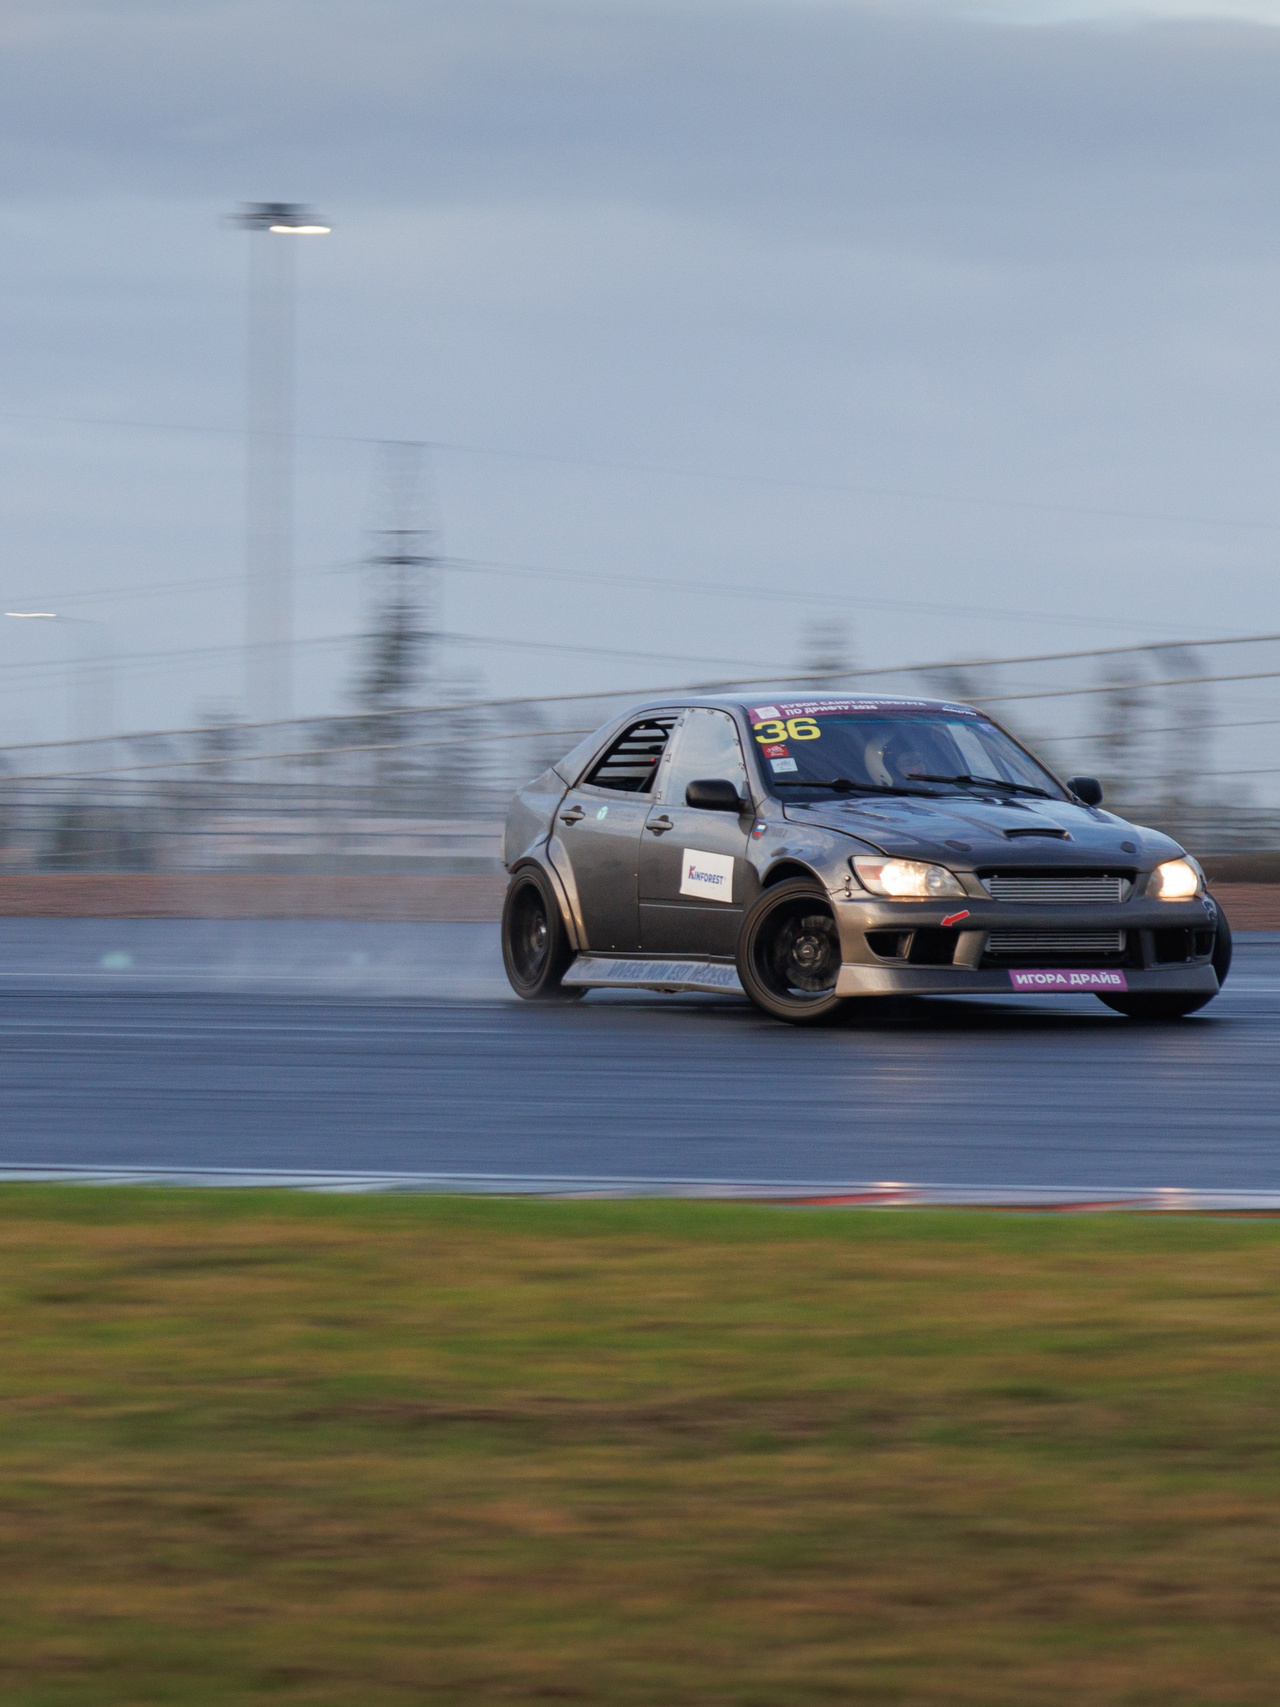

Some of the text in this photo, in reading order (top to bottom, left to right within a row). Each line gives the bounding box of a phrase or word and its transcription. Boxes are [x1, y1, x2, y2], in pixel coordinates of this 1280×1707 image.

[785, 708, 803, 716] ПО
[805, 705, 849, 715] ДРИФТУ
[753, 717, 822, 744] 36
[688, 865, 724, 885] KINFOREST
[1016, 972, 1121, 985] ИГОРА ДРАЙВ
